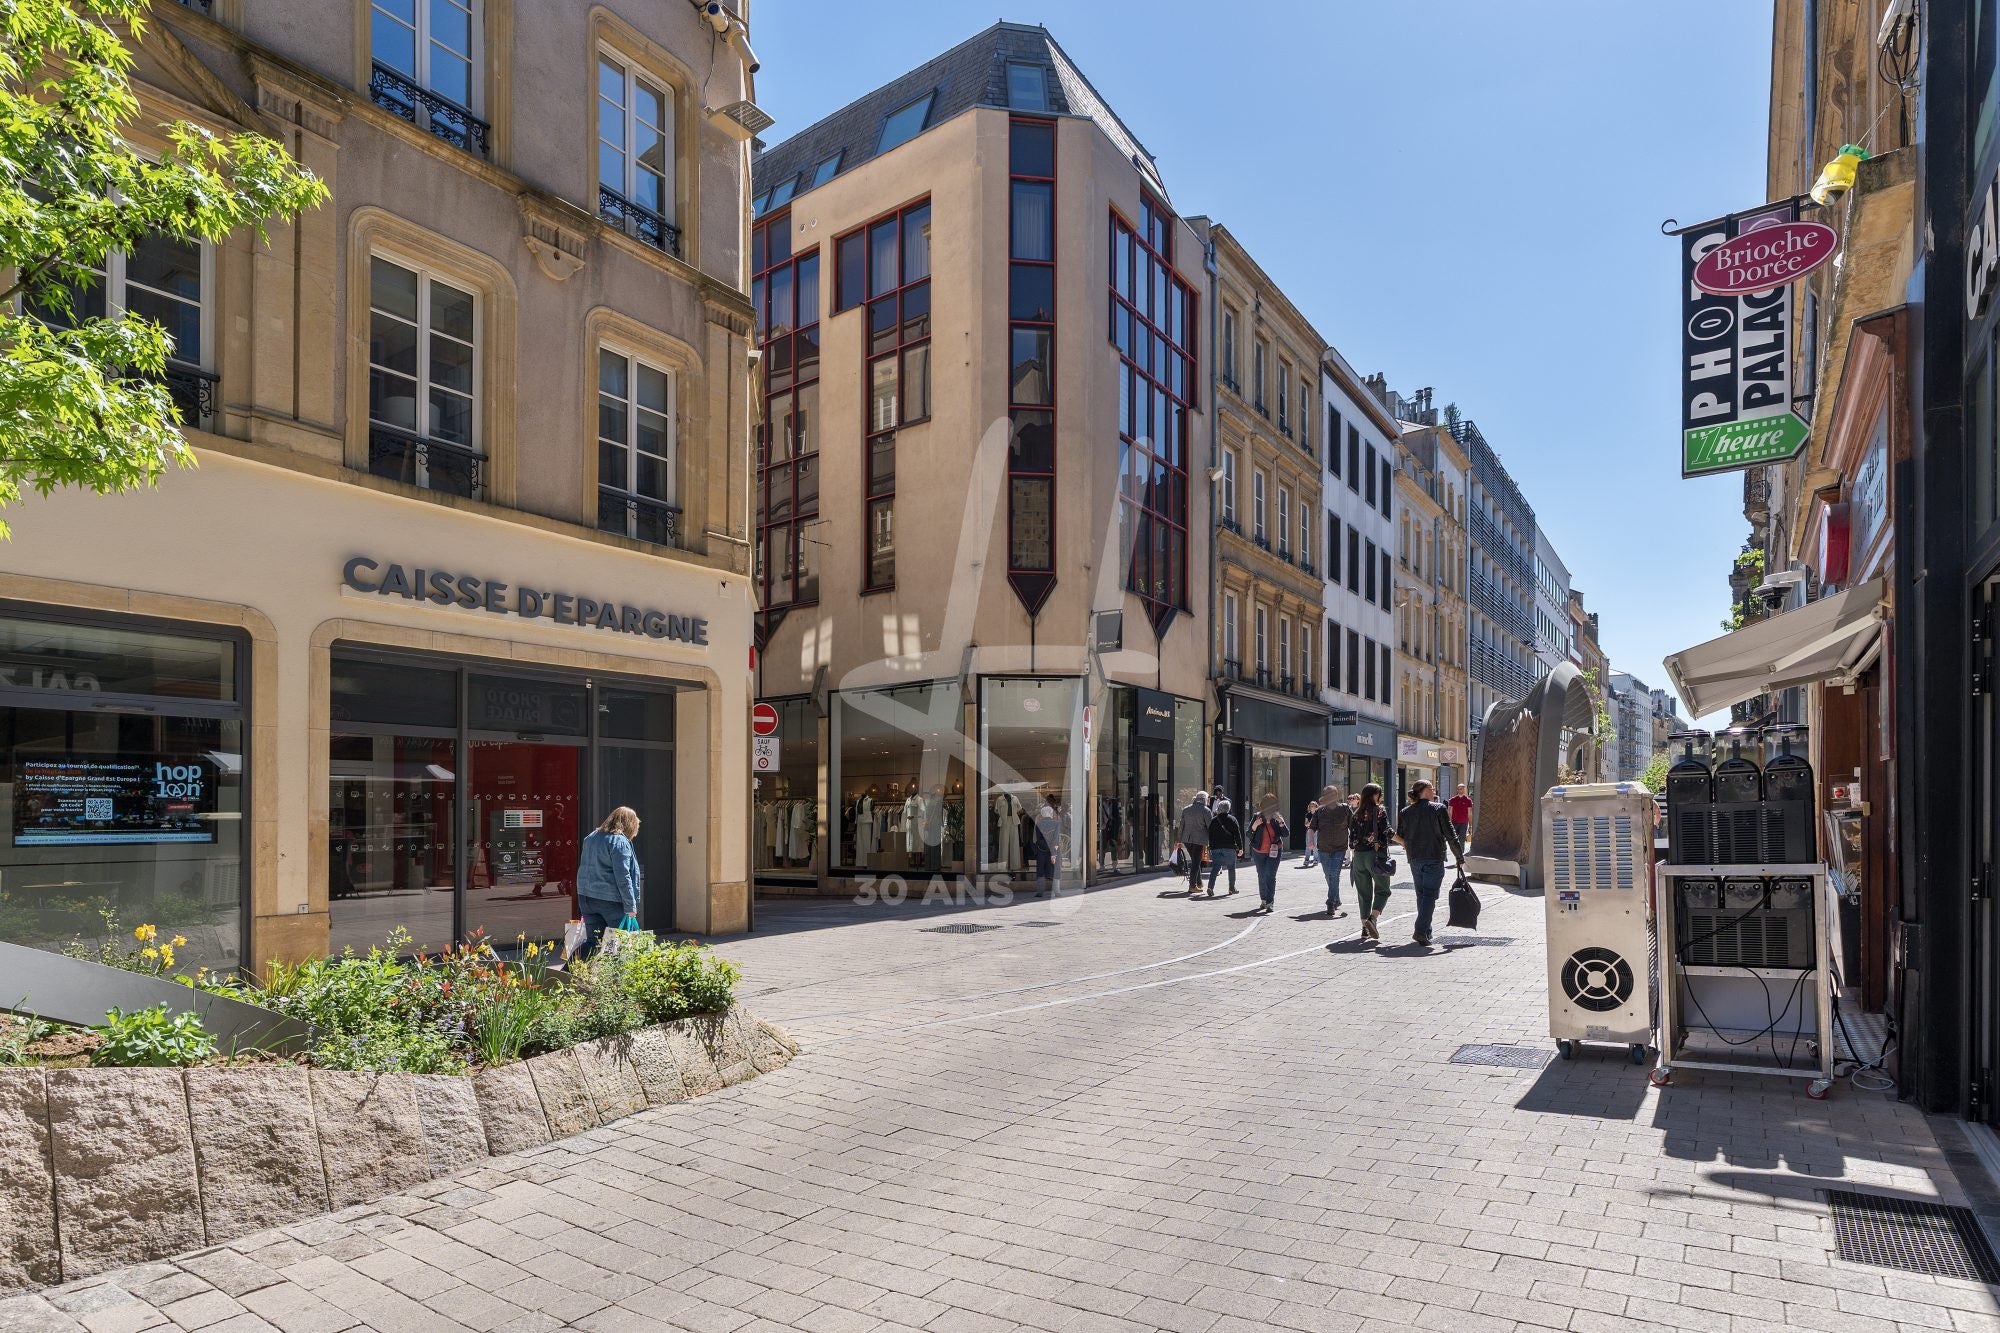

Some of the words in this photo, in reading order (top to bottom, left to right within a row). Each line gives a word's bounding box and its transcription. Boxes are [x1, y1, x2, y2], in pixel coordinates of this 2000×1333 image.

[1715, 229, 1820, 272] Brioche
[1966, 162, 2000, 321] CA
[1727, 253, 1803, 288] Dorée
[1688, 232, 1735, 421] PHO
[1742, 283, 1785, 411] PALAC
[1712, 426, 1785, 455] heure
[342, 556, 509, 615] CAISSE
[517, 586, 710, 647] D'EPARGNE
[1333, 714, 1356, 722] minelli
[25, 761, 57, 769] Participez
[156, 761, 202, 783] hop
